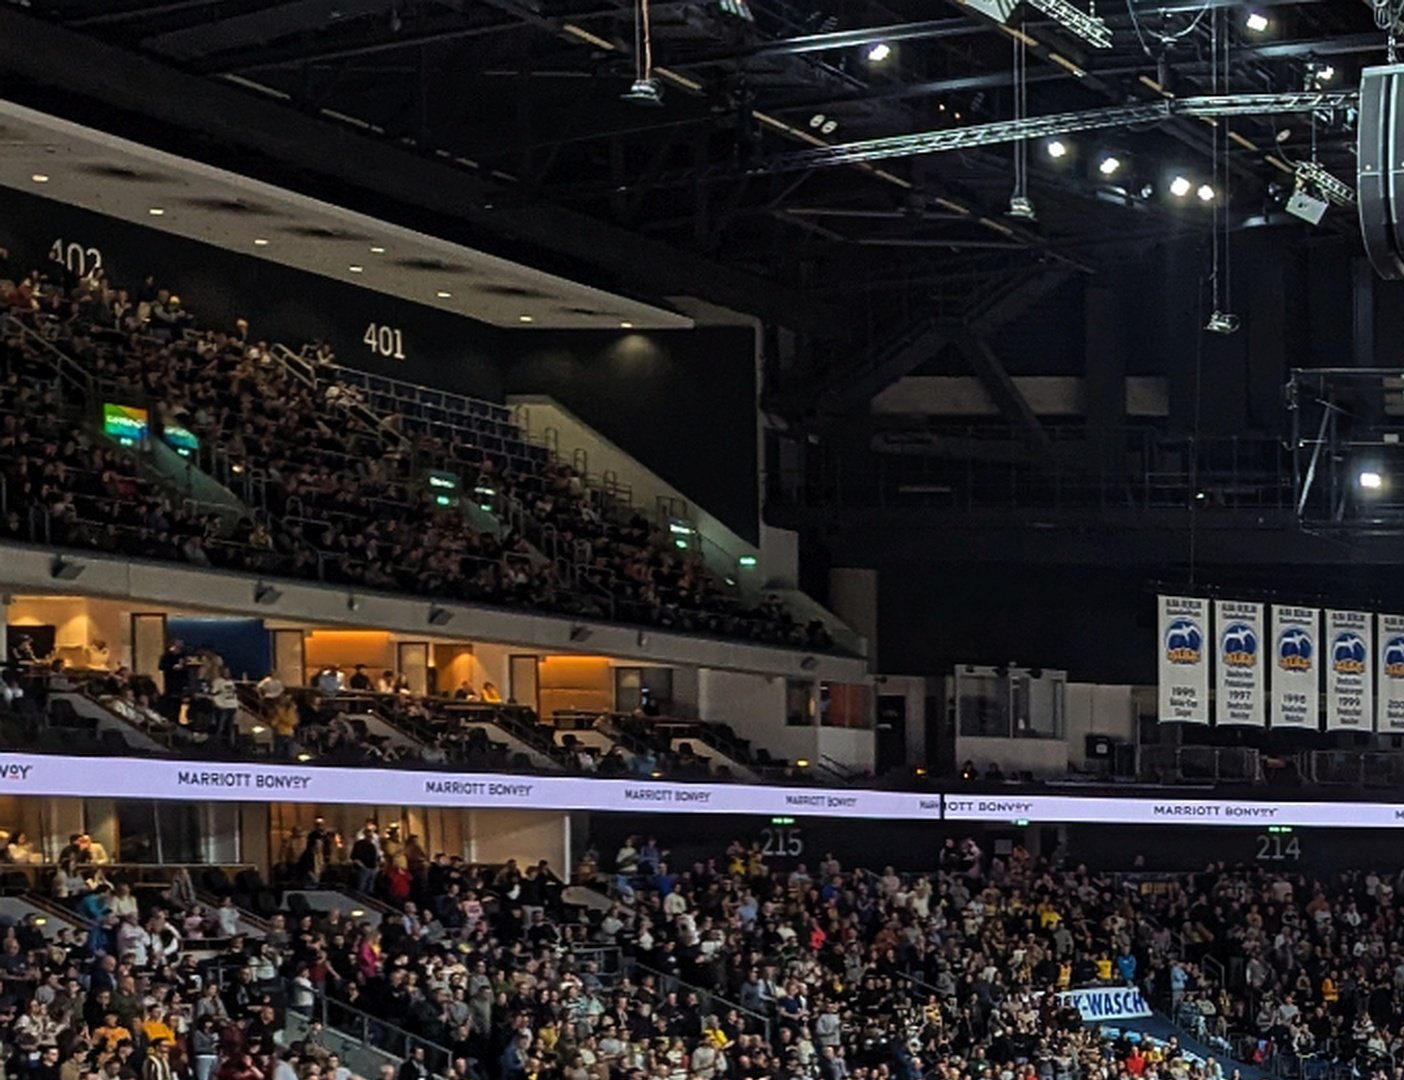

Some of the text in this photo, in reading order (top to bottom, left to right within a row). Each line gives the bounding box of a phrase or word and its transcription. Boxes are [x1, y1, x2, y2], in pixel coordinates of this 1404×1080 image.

[363, 322, 406, 360] 401
[1229, 690, 1252, 701] 1997
[178, 770, 312, 790] MARRIOTT BONVOY
[425, 781, 534, 798] MARRIOTT BONVOY
[625, 788, 674, 802] MARRIOTT
[785, 795, 826, 807] MARRIOTT
[1153, 805, 1278, 819] MARRIOTT BONVOY
[760, 828, 802, 857] 215
[1256, 834, 1301, 860] 214
